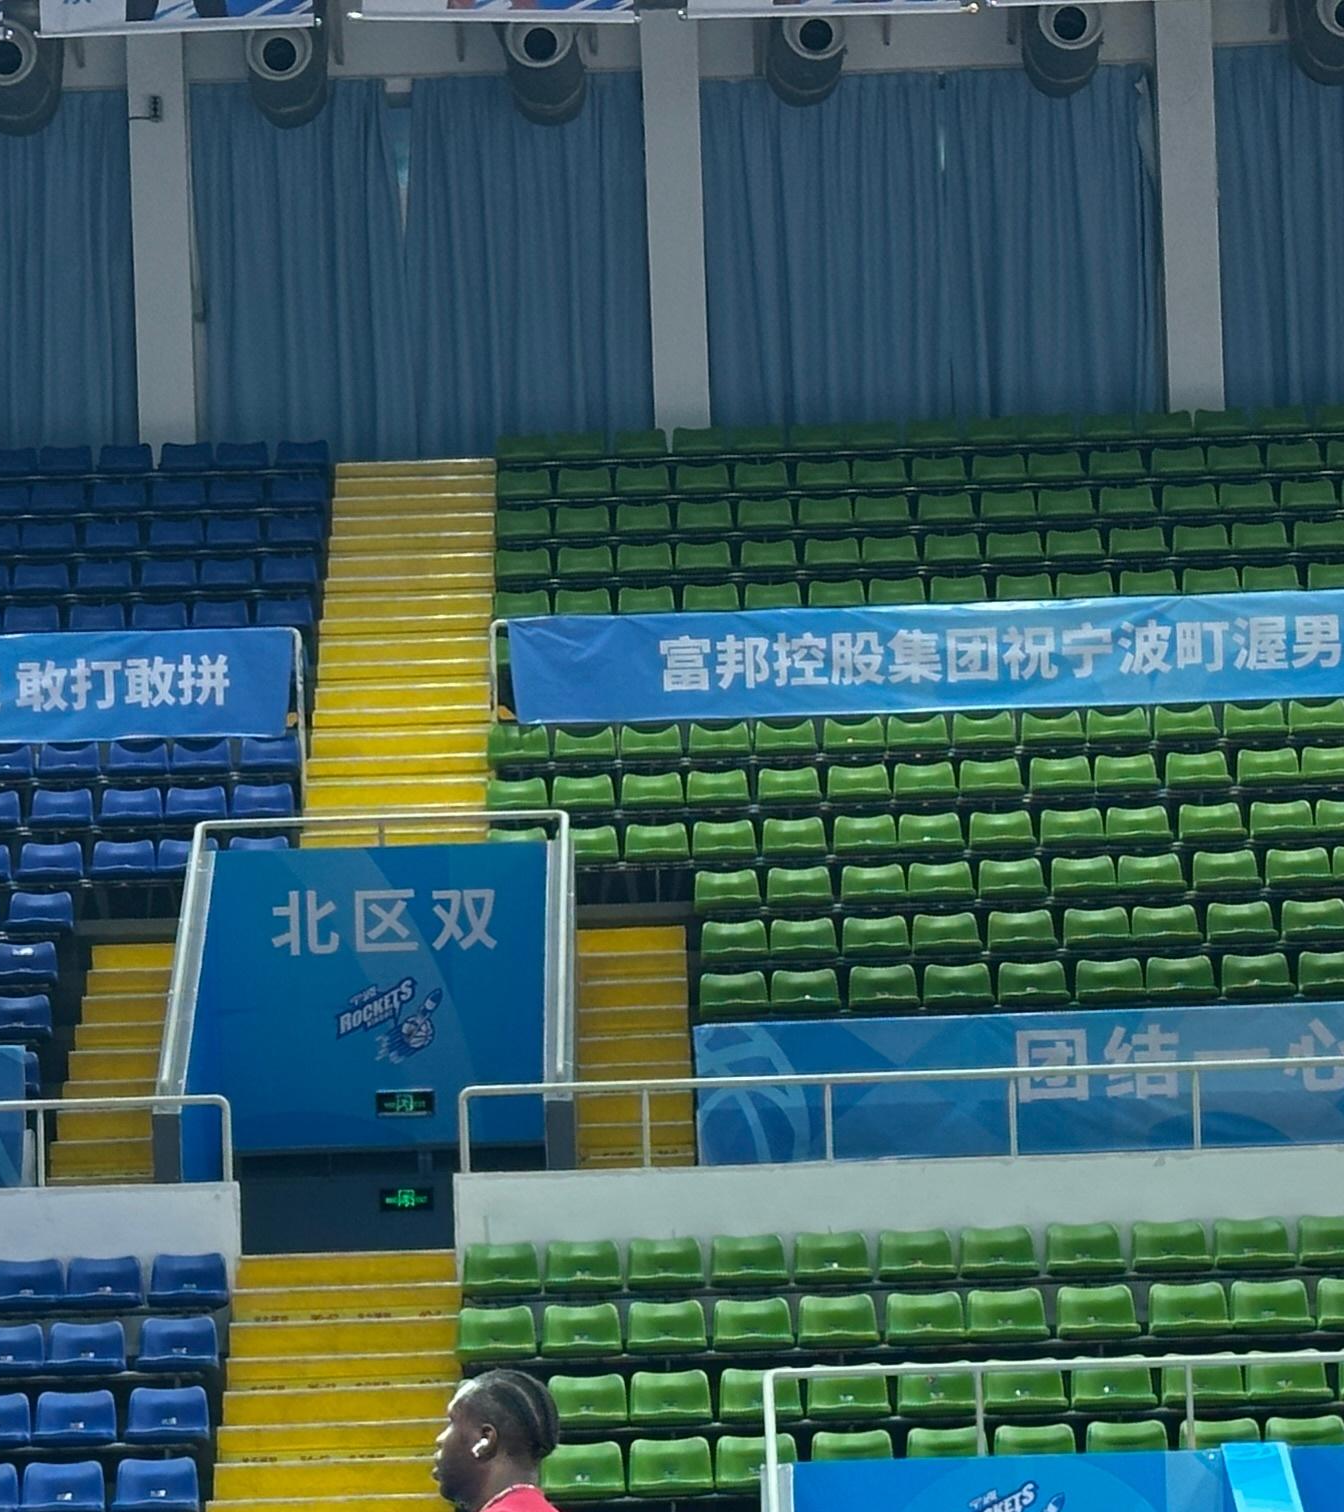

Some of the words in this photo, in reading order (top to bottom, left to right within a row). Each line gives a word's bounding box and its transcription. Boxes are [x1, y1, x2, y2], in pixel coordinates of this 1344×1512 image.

[15, 654, 230, 712] 敢打敢拼
[272, 888, 498, 956] 北区双
[338, 977, 415, 1037] ROCKETS
